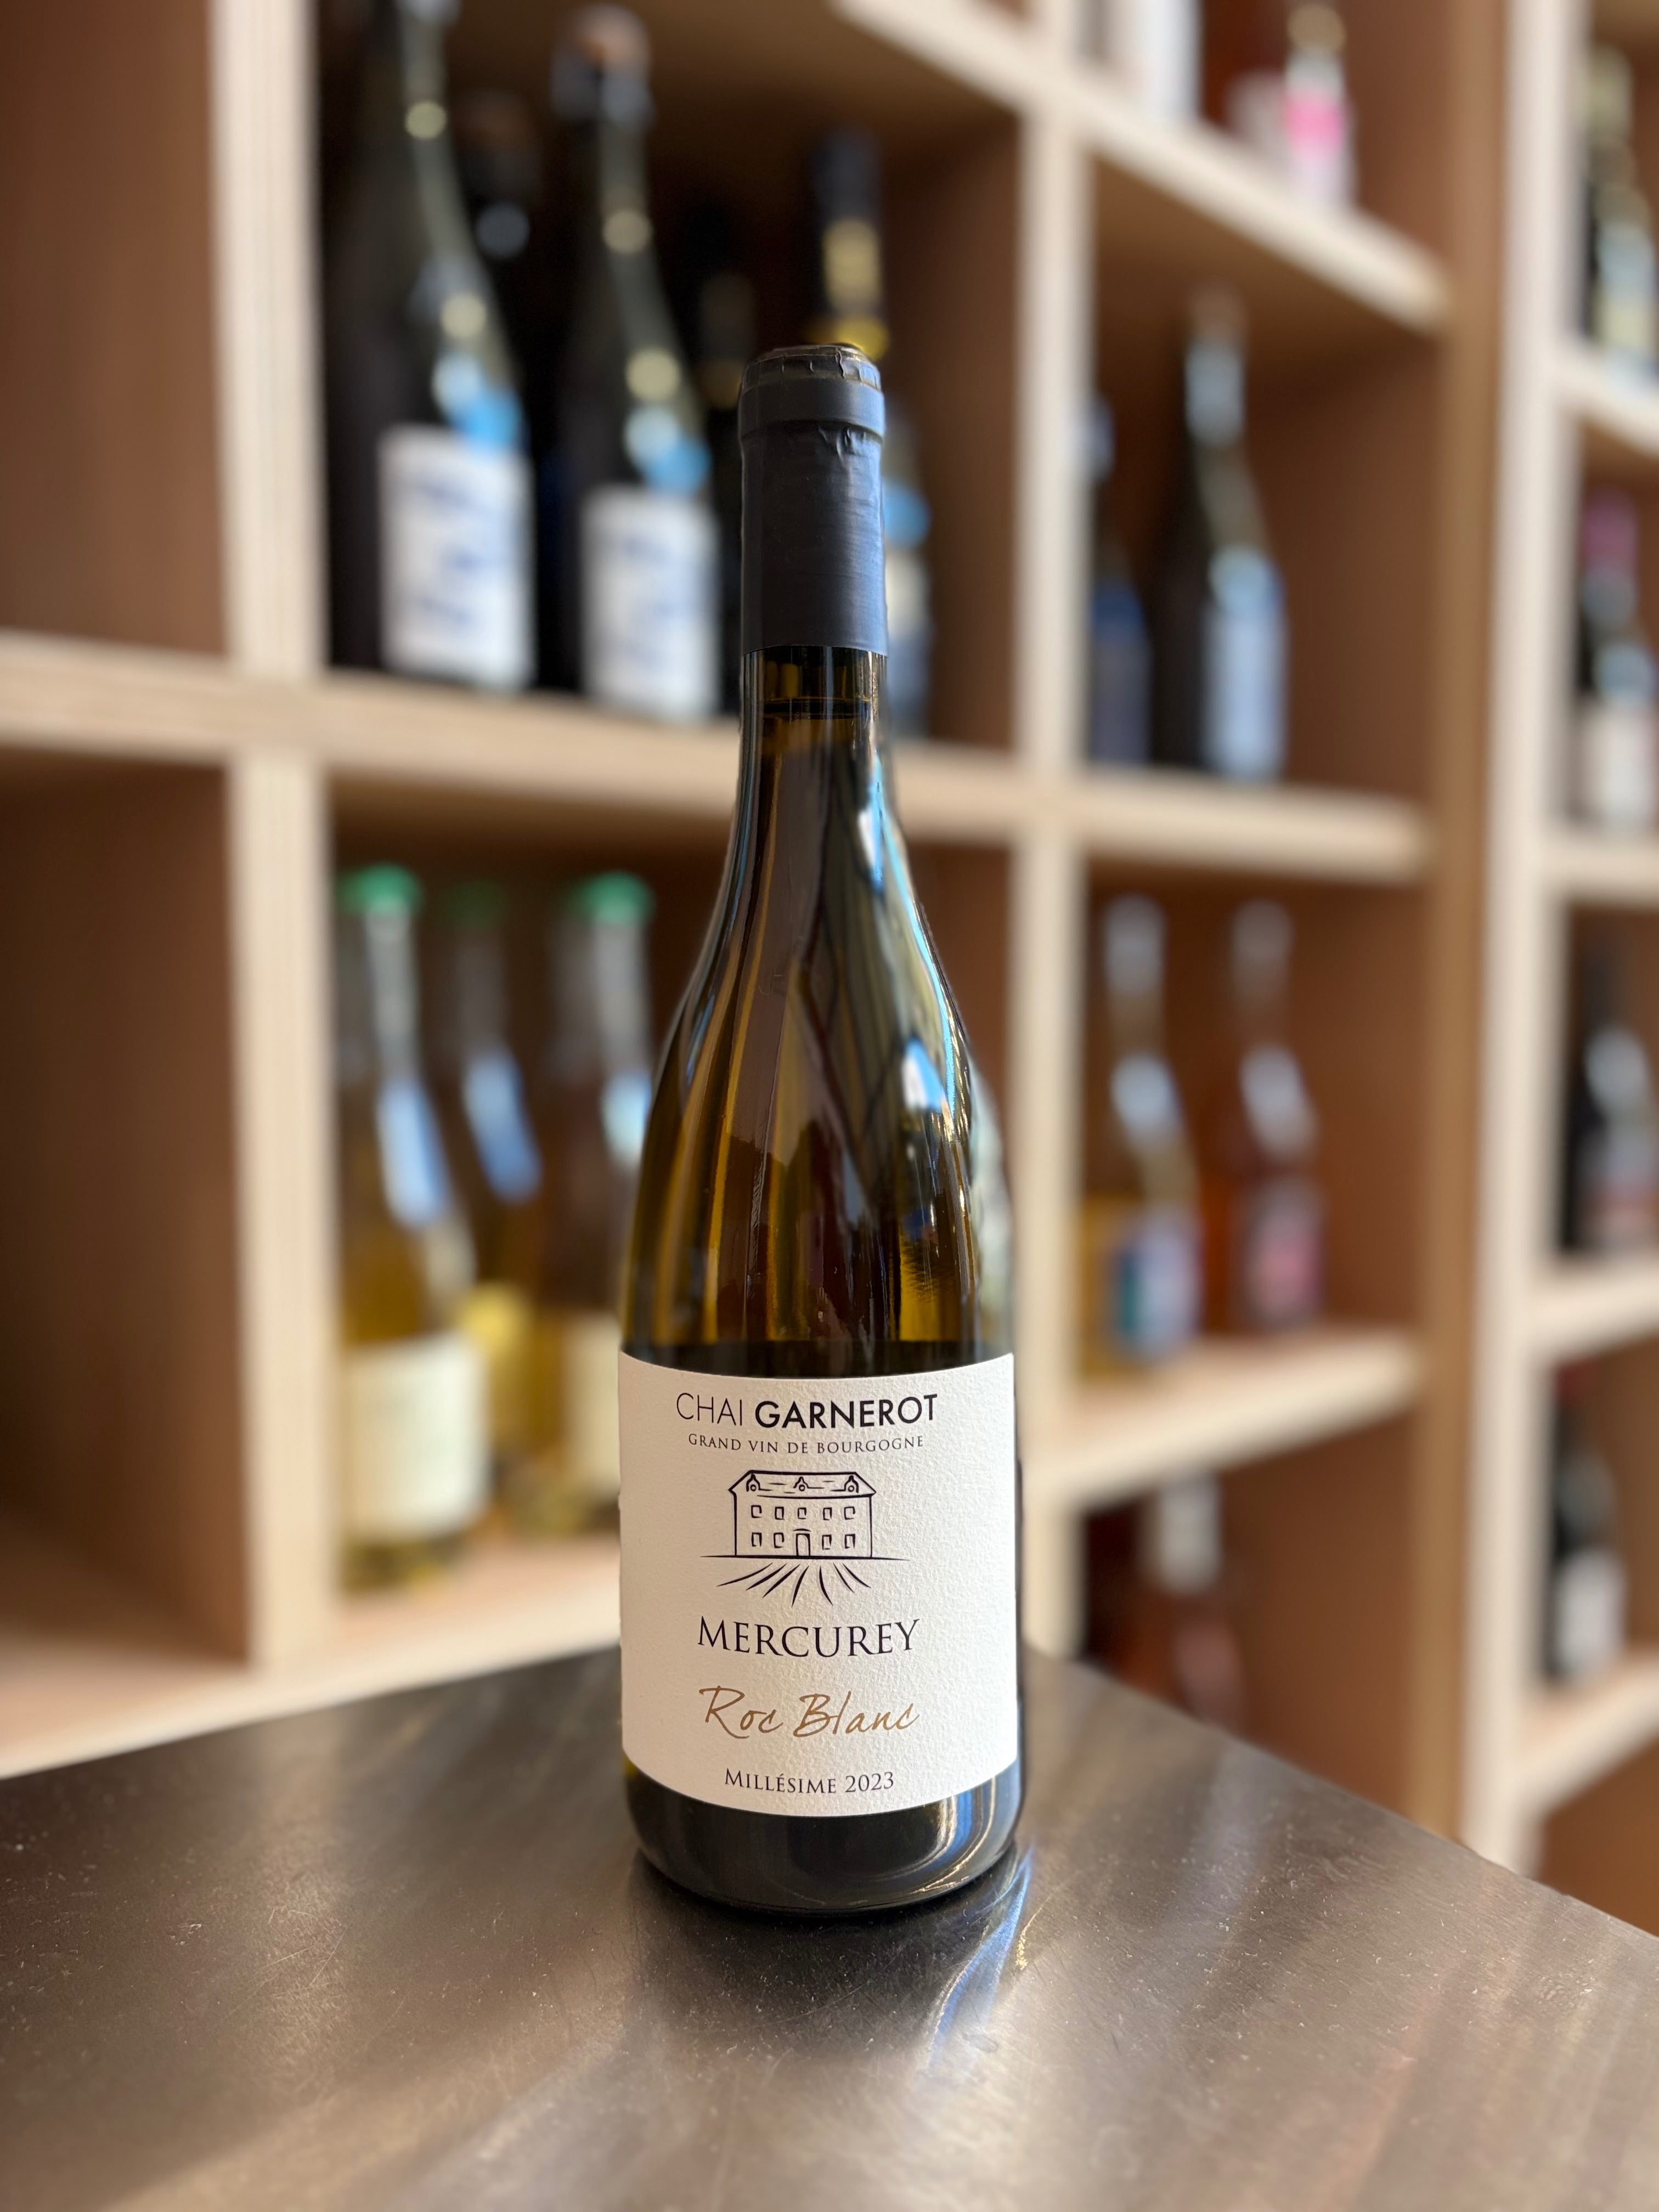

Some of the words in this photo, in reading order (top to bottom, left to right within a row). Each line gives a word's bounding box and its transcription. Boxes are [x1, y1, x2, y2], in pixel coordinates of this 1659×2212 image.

[676, 1392, 742, 1426] CHAI
[755, 1393, 938, 1429] GARNEROT
[689, 1433, 741, 1451] GRAND
[748, 1440, 778, 1453] VIN
[787, 1442, 808, 1454] DE
[817, 1435, 923, 1454] BOURGOGNE
[697, 1616, 921, 1658] MERCUREY
[698, 1685, 783, 1739] Roc
[793, 1690, 920, 1738] Blanc
[725, 1768, 837, 1794] MILLÉSIME
[845, 1771, 894, 1793] 2023
